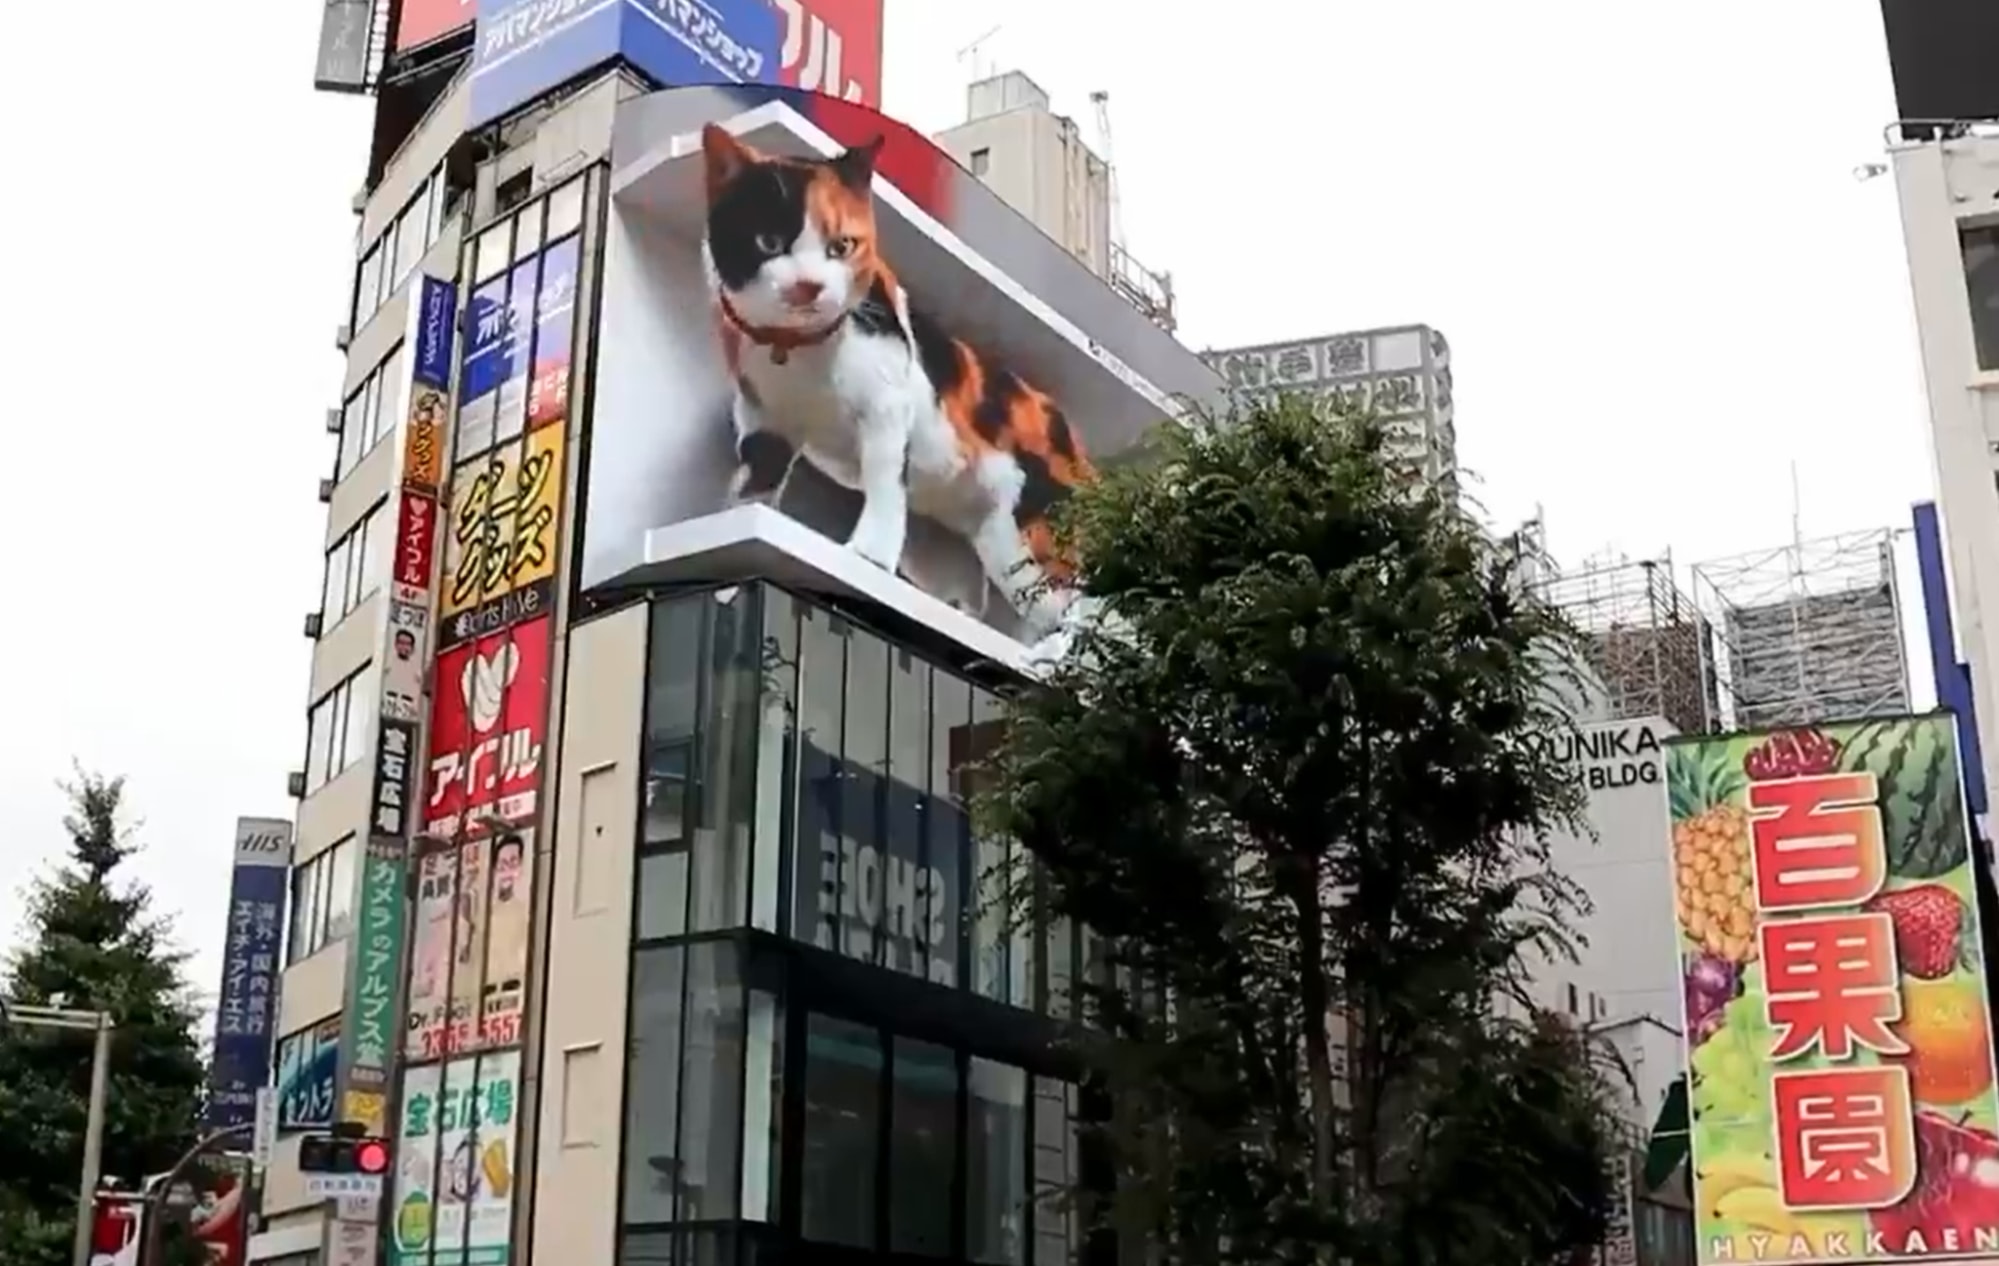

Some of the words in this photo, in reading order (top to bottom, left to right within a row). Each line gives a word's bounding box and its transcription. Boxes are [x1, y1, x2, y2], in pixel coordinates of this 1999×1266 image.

[430, 727, 541, 807] アイフル
[355, 861, 396, 1067] カメラのアルプス堂
[1748, 773, 1918, 1212] 百果園
[1712, 1227, 1999, 1259] HYAKKAEN
